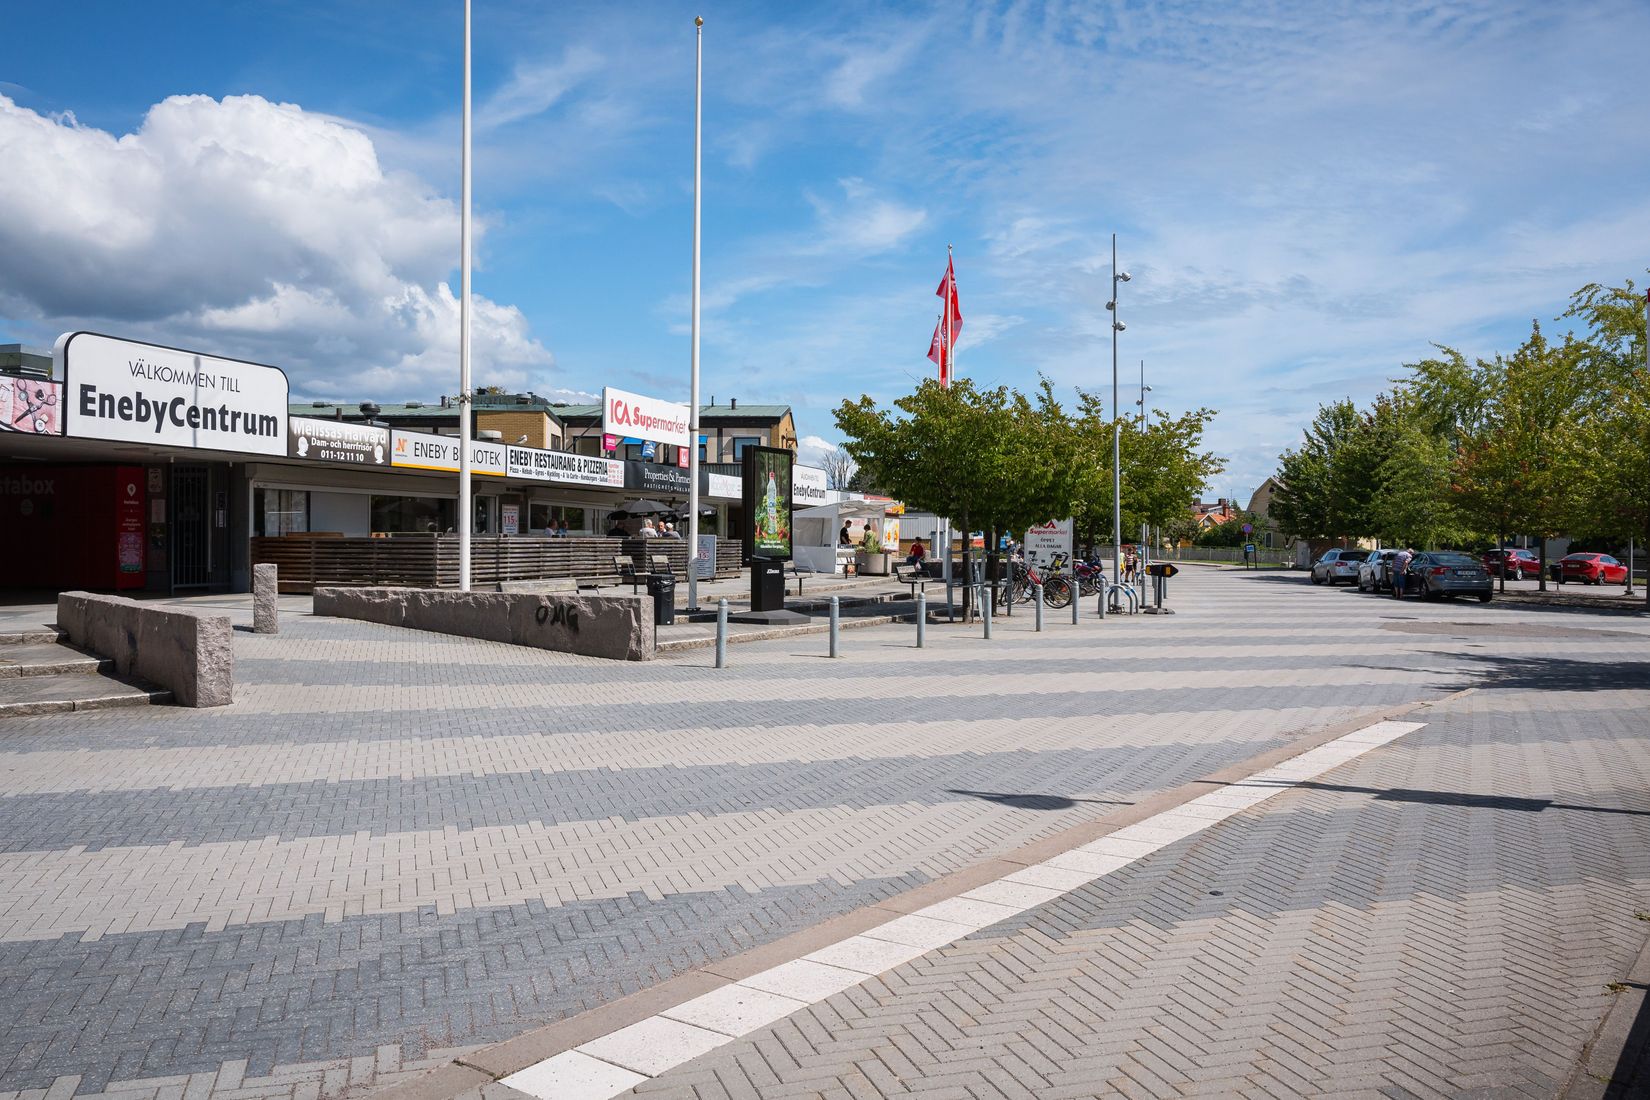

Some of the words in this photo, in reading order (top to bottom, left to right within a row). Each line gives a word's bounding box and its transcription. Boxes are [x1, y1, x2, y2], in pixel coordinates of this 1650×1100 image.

[129, 358, 216, 389] VÄLKOMMEN
[220, 376, 241, 393] TILL
[79, 383, 278, 438] EnebyCentrum
[610, 398, 632, 427] ICA
[633, 406, 686, 435] Supermarket
[294, 420, 343, 439] Melissas
[311, 437, 329, 447] Dam-
[330, 439, 341, 449] och
[342, 440, 373, 452] herrfrisör
[414, 442, 448, 460] ENEBY
[452, 446, 501, 466] BIOTEK
[510, 449, 533, 467] ENEBY
[534, 452, 576, 472] RESTAURANG
[577, 458, 582, 473] &
[583, 459, 608, 476] PIZZERIA
[794, 484, 825, 500] EnebyCentrum
[1029, 528, 1068, 536] Supermarket
[535, 603, 580, 633] OMG
